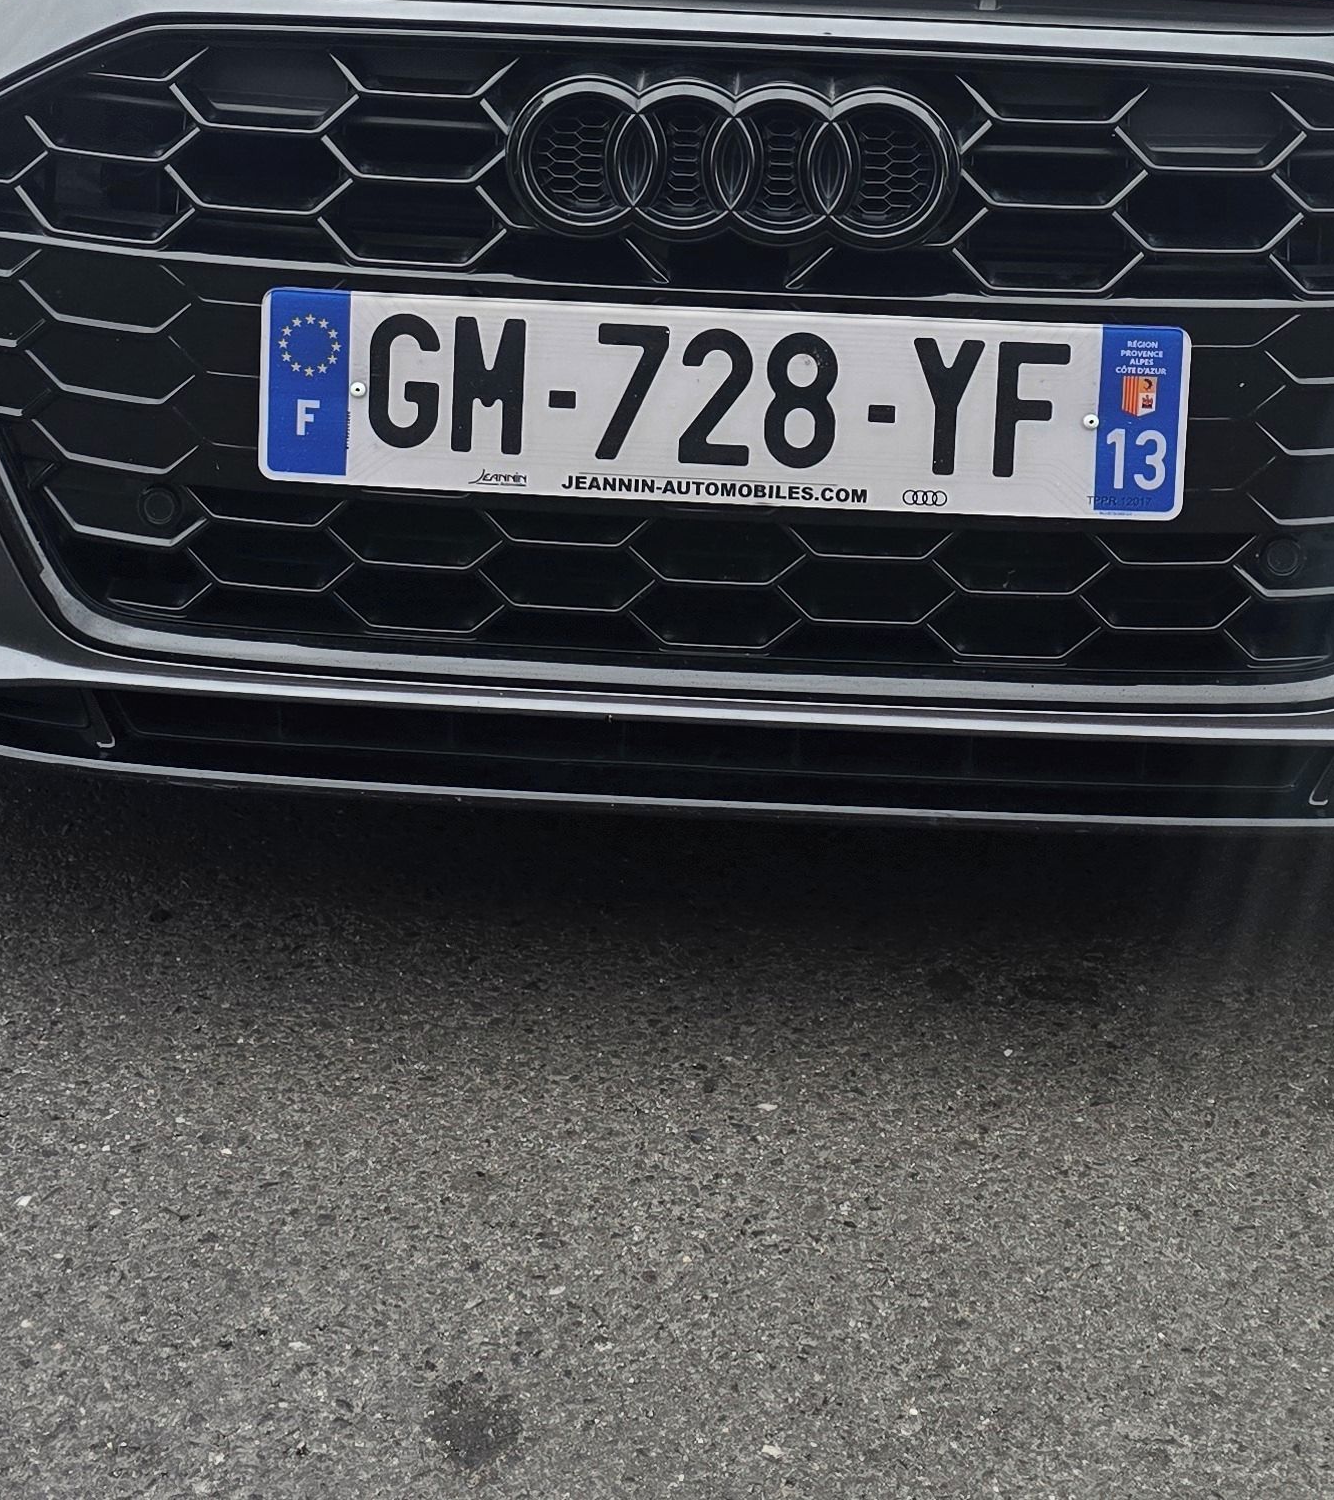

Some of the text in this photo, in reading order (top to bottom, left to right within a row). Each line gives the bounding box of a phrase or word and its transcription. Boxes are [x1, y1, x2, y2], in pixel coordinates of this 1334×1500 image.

[1120, 349, 1164, 358] PROVENCE
[1127, 340, 1159, 349] RÉGION
[1115, 365, 1167, 375] CÔTE D'AZUR
[1129, 358, 1154, 366] ALPES
[369, 313, 1071, 477] GM-728-YF
[296, 399, 320, 435] F
[1107, 428, 1167, 490] 13
[561, 475, 868, 503] JEANNIN-AUTOMOBILES.COM
